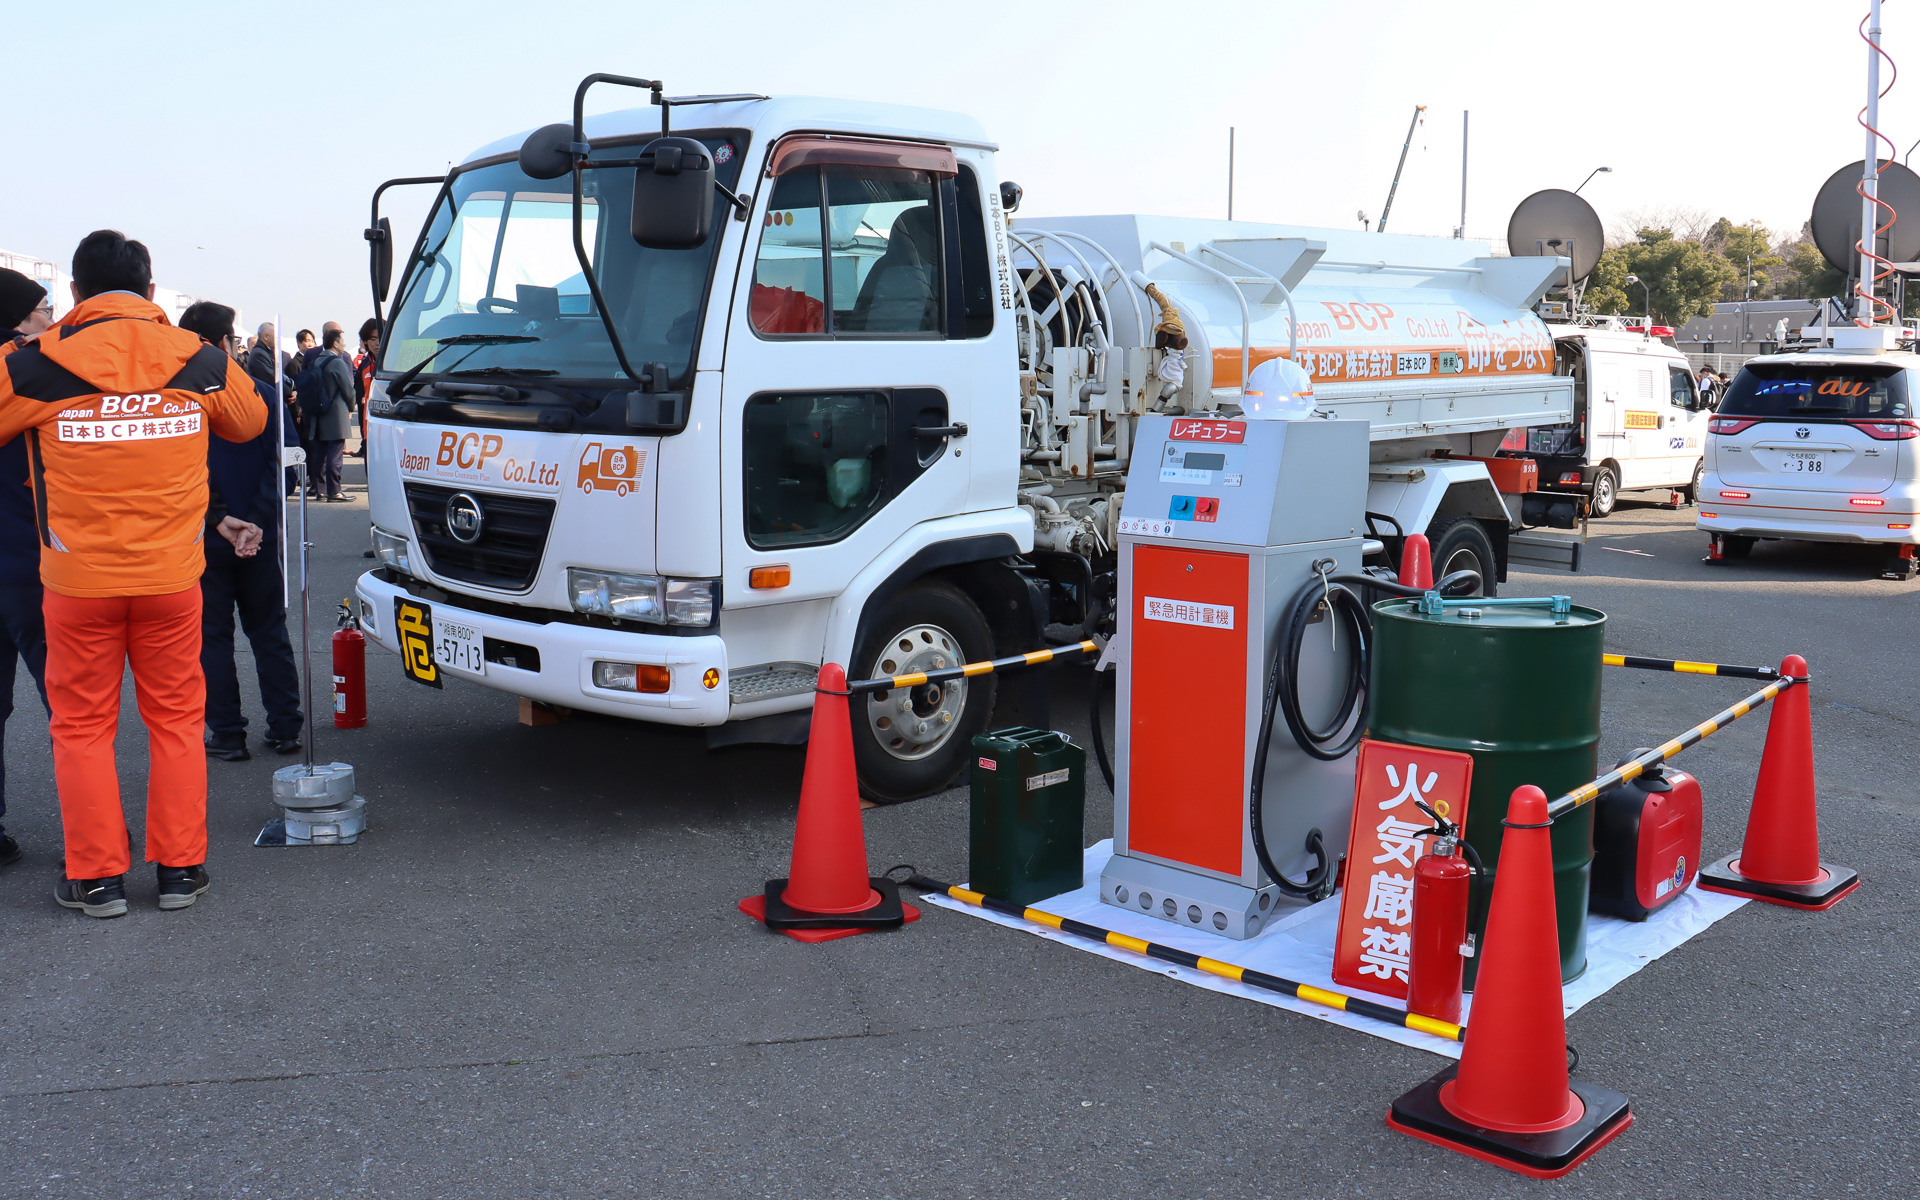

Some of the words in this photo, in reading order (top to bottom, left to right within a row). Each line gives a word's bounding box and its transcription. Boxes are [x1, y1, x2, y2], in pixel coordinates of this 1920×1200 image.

[989, 193, 1012, 310] 日本BCP株式会社
[1320, 302, 1395, 331] BCP
[1456, 311, 1550, 373] 命をつなぐ
[1432, 357, 1439, 370] で
[1817, 380, 1871, 397] au
[58, 409, 94, 420] Japan
[100, 394, 162, 413] BCP
[62, 417, 199, 440] 日本BCP株式会社
[1173, 422, 1242, 440] レギュラー
[400, 448, 431, 474] Japan
[436, 431, 504, 470] BCP
[503, 458, 560, 487] Co.Ltd.
[612, 463, 625, 471] BCP
[614, 455, 624, 463] 日本
[1149, 600, 1230, 626] 緊急用計量機
[397, 602, 436, 682] 危
[1357, 763, 1439, 985] 火気厳禁
